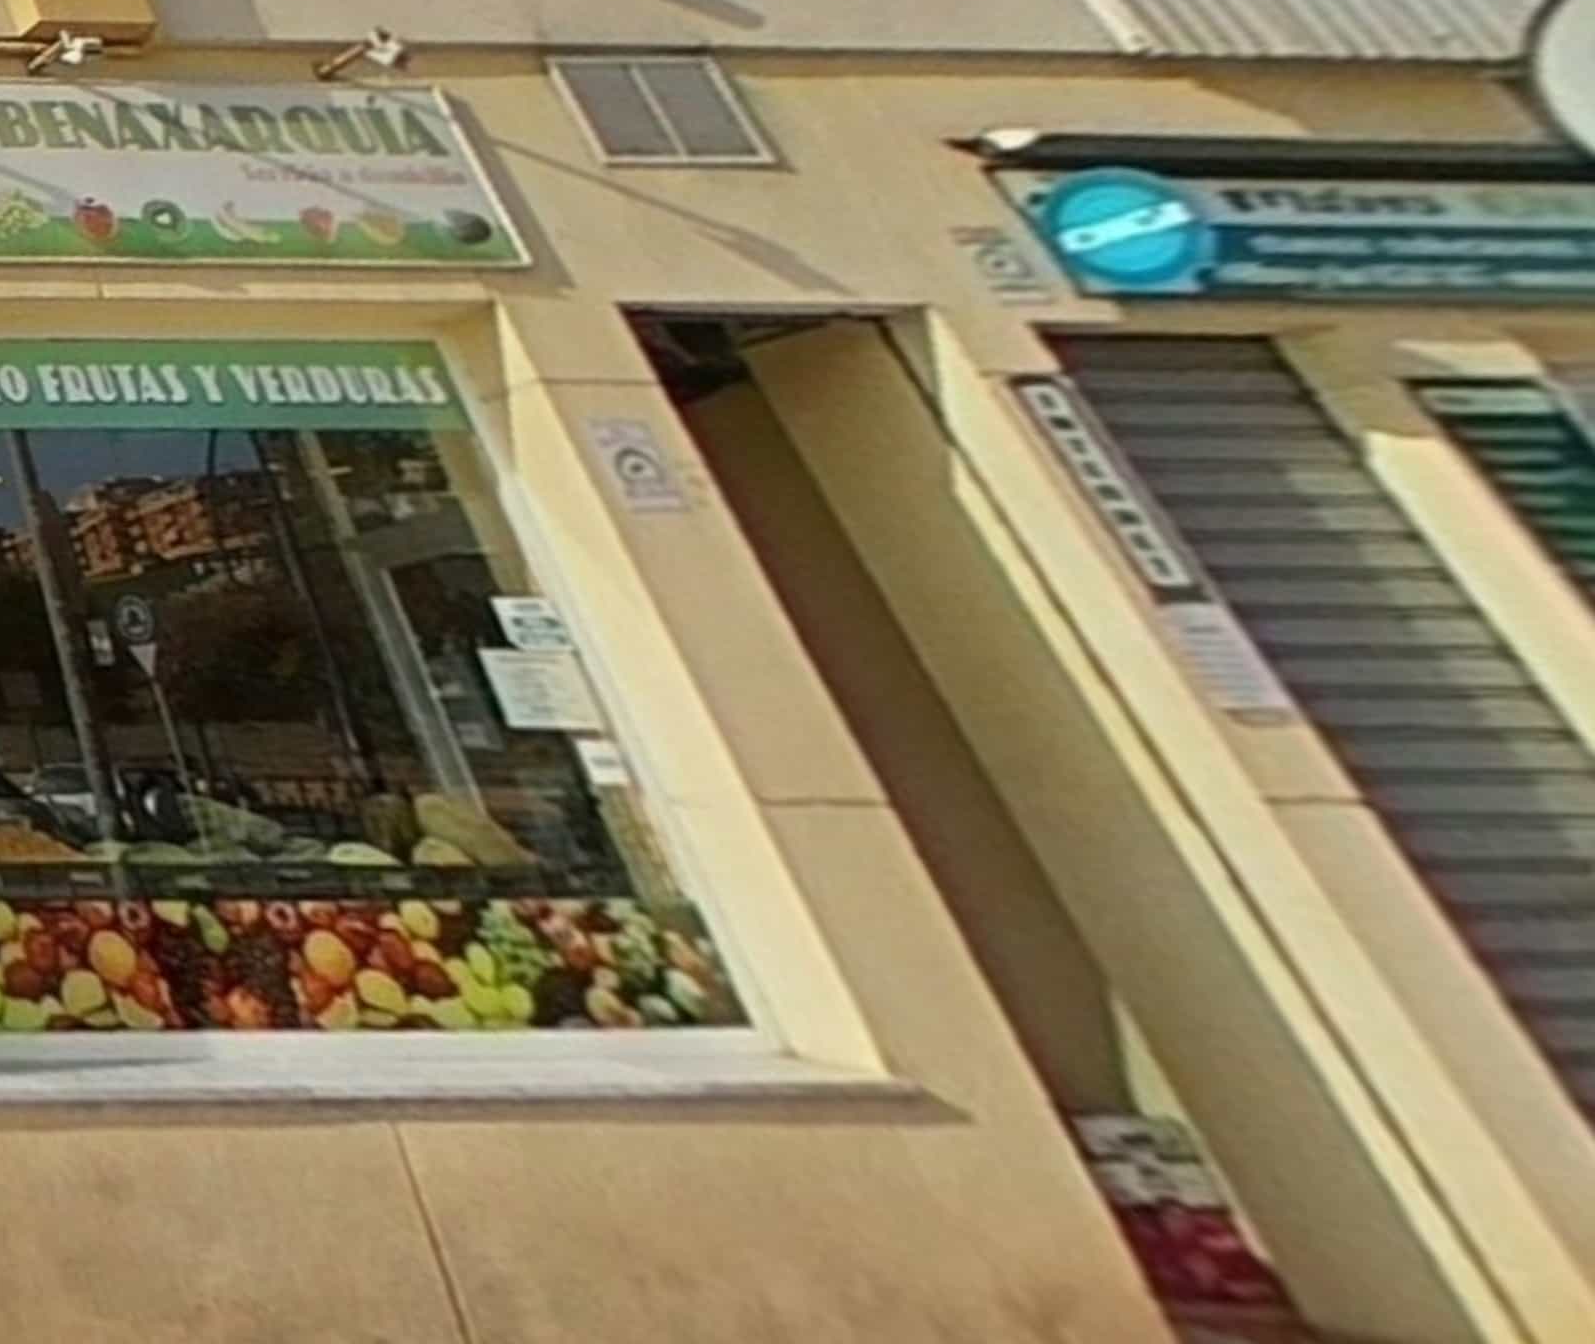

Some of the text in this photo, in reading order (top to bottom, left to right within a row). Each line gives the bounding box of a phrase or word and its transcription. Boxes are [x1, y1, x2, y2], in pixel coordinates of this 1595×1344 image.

[35, 363, 189, 404] FRUTAS
[191, 364, 224, 403] Y
[227, 364, 448, 405] VERDURAS
